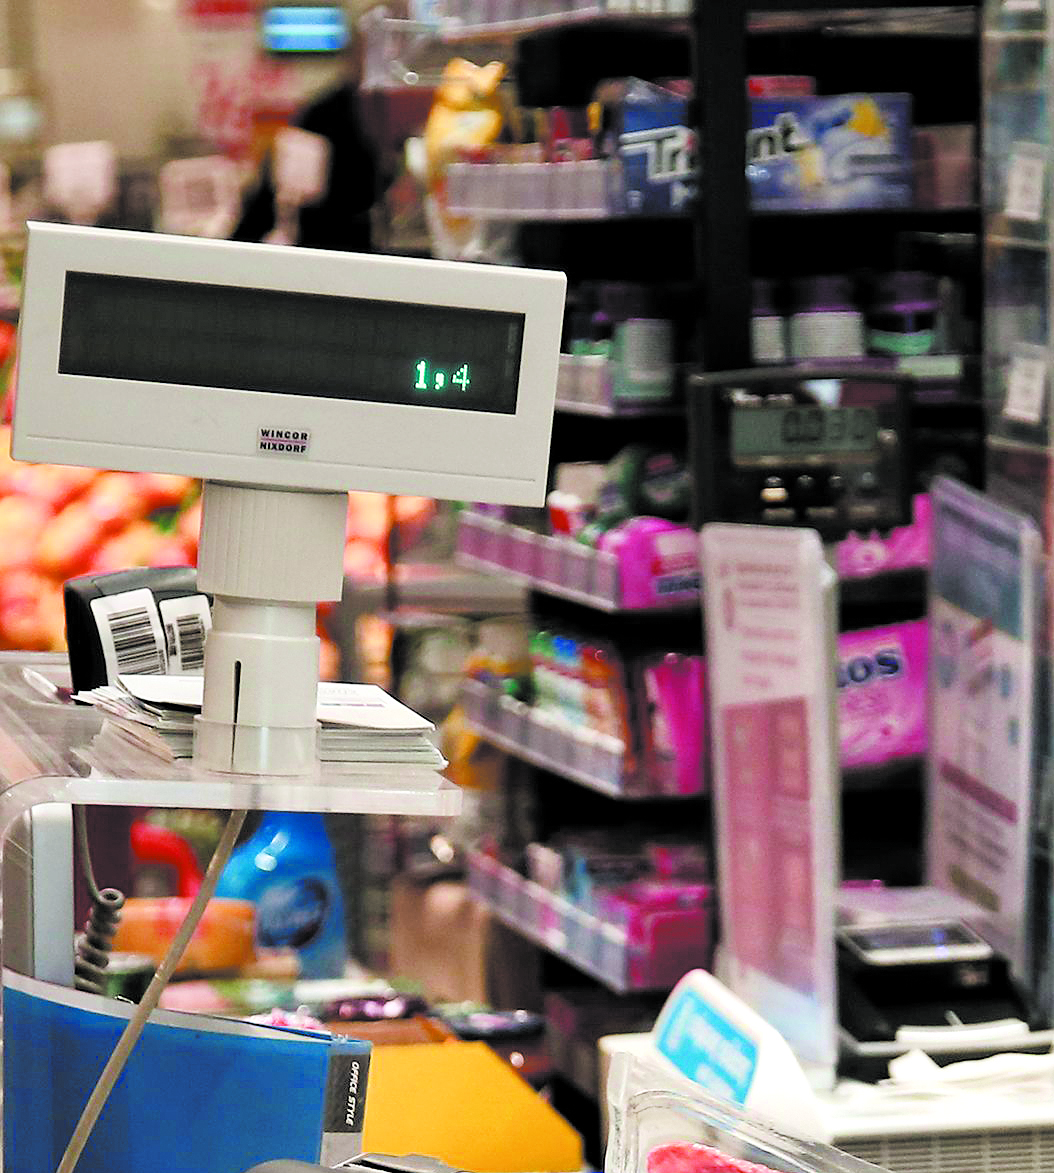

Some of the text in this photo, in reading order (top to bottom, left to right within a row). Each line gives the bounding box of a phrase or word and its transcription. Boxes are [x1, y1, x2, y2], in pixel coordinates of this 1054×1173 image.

[620, 112, 808, 184] Trint
[259, 441, 307, 453] NIXDORF
[260, 428, 309, 441] WINCOR
[345, 1060, 360, 1127] OFFICE STYLE
